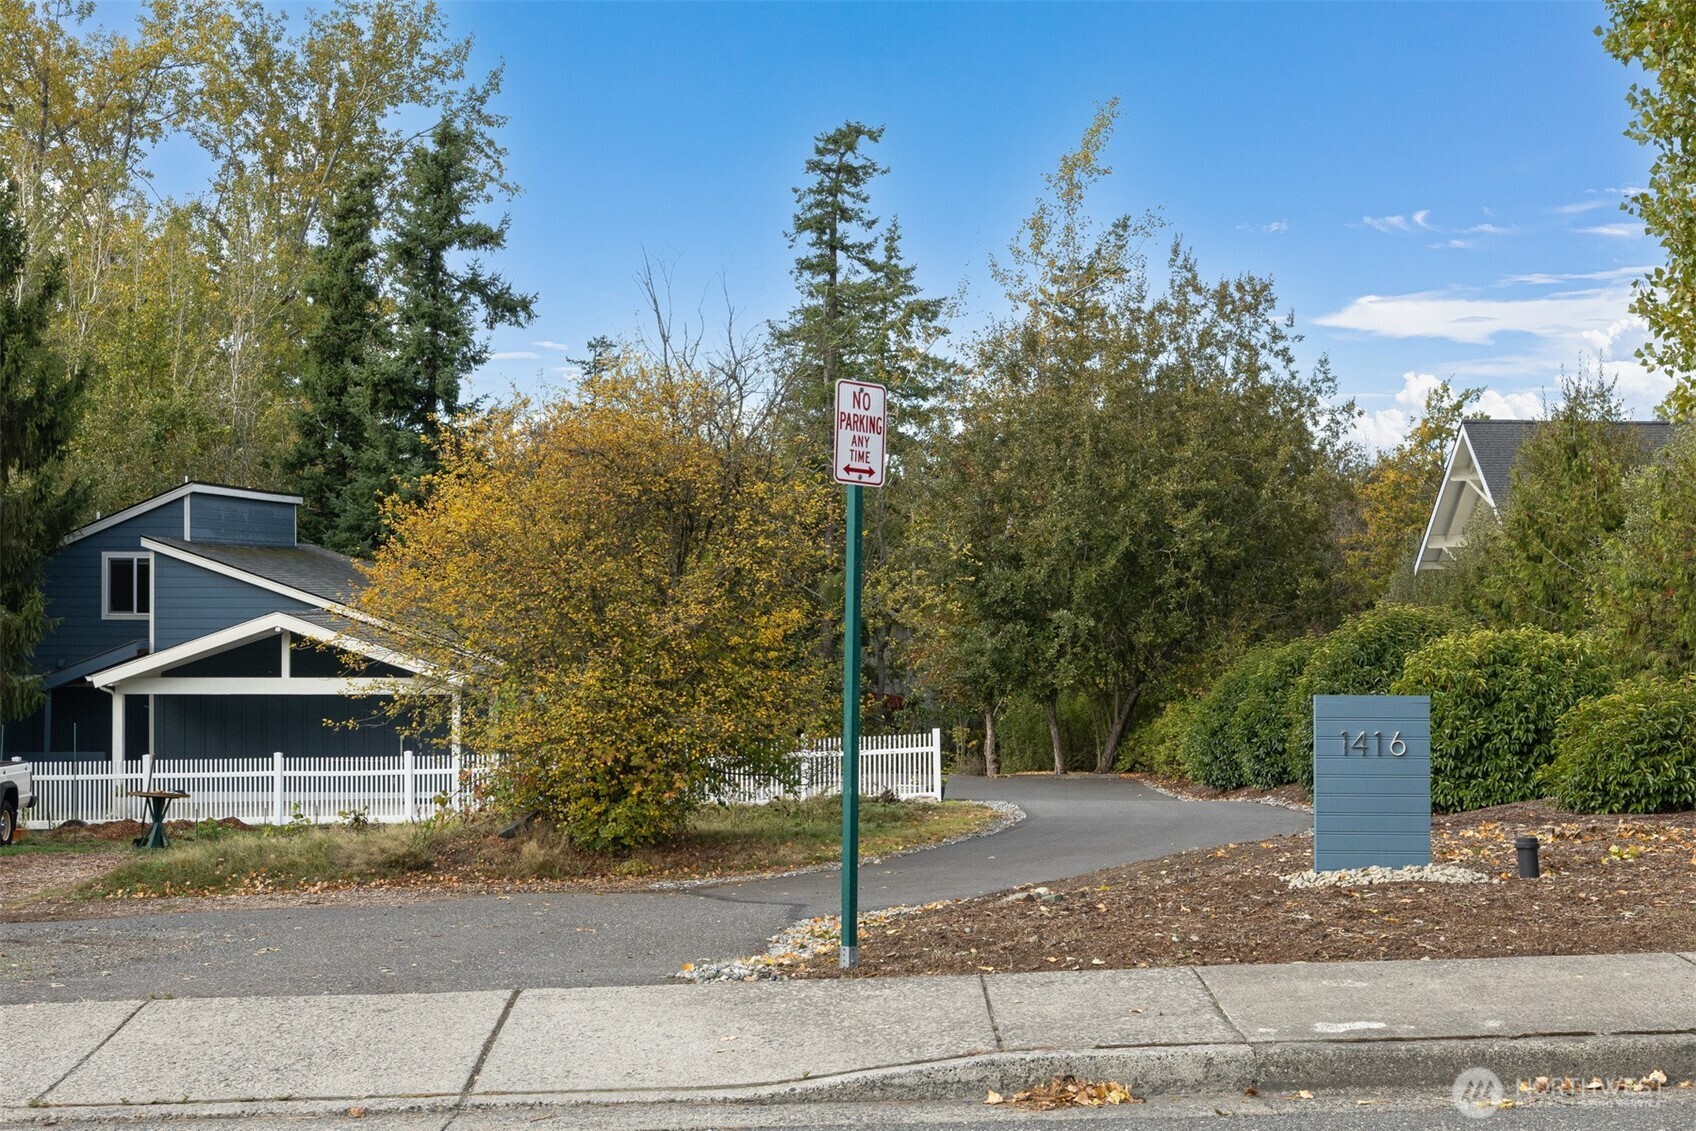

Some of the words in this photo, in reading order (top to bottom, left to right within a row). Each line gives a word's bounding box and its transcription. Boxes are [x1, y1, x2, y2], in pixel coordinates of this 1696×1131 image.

[853, 391, 871, 411] NO
[840, 411, 882, 435] PARKING
[851, 434, 870, 448] ANY
[850, 449, 870, 464] TIME
[1340, 730, 1407, 757] 1416
